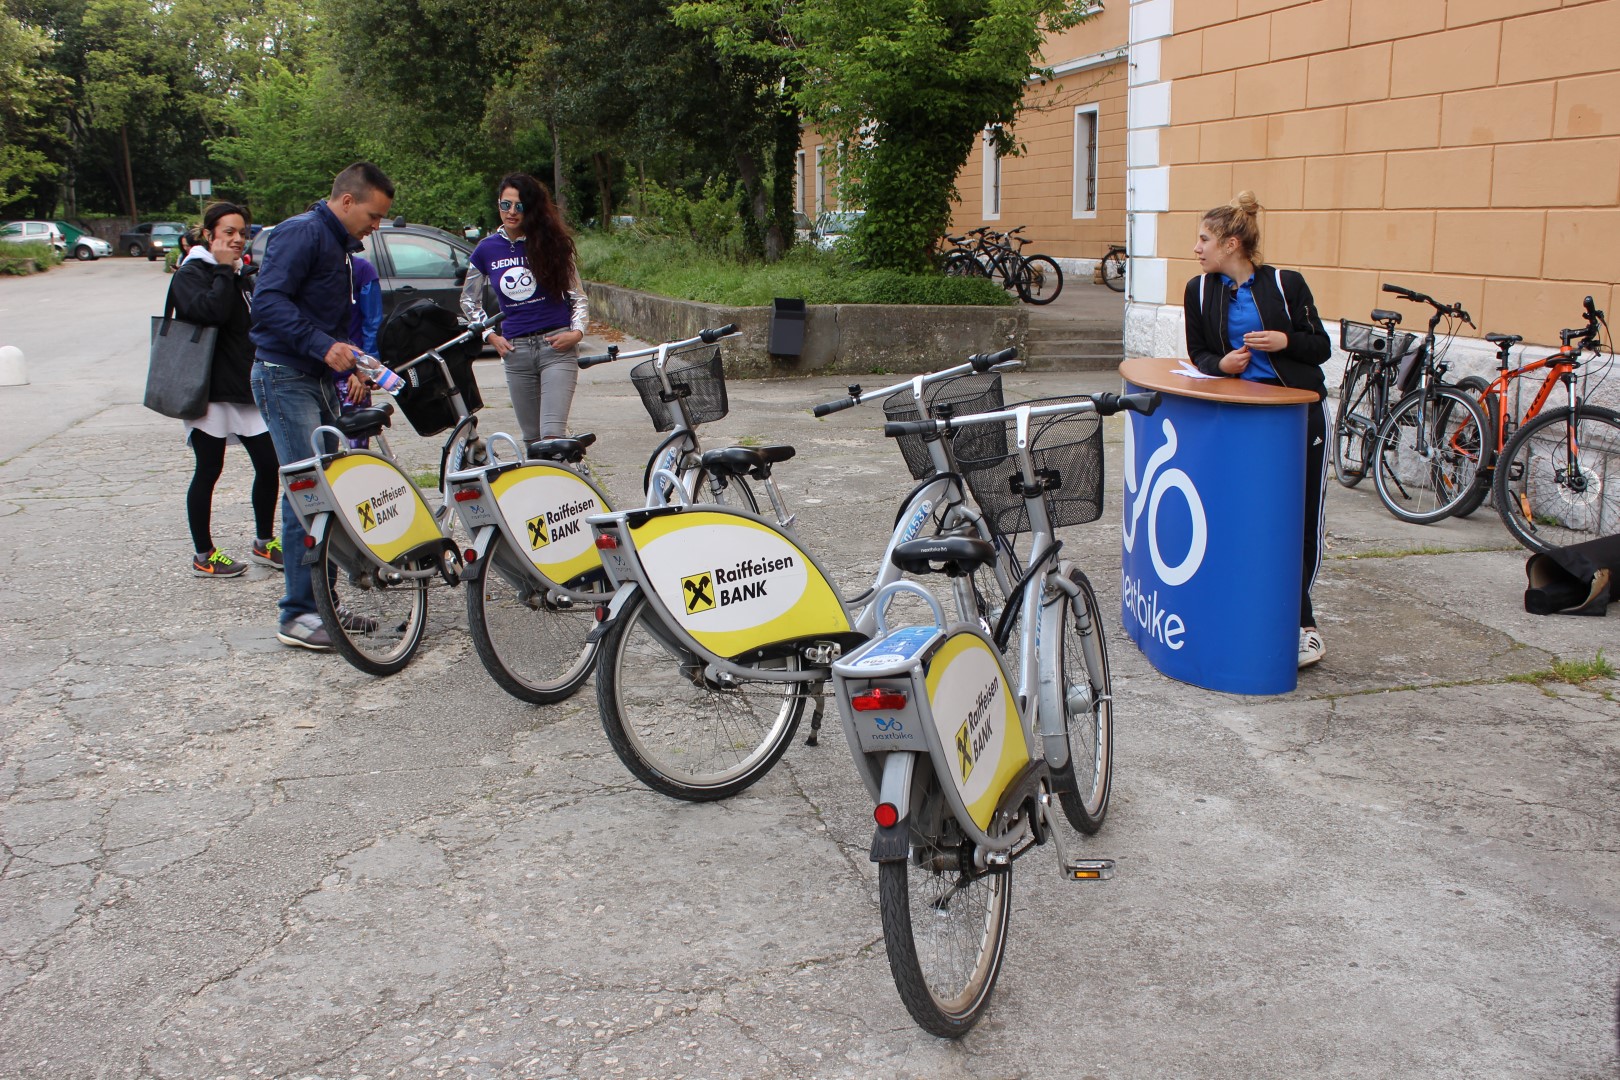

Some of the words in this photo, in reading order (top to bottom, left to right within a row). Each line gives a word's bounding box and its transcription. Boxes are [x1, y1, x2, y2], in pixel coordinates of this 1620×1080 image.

[491, 256, 519, 270] SJEDNI
[371, 485, 407, 509] Raiffeisen
[376, 504, 399, 525] BANK
[546, 499, 594, 525] Raiffeisen
[551, 519, 580, 542] BANK
[715, 556, 794, 585] Raiffeisen
[720, 580, 767, 607] BANK
[968, 676, 999, 734] Raiffeisen
[872, 731, 914, 740] nextbike
[973, 714, 992, 762] BANK
